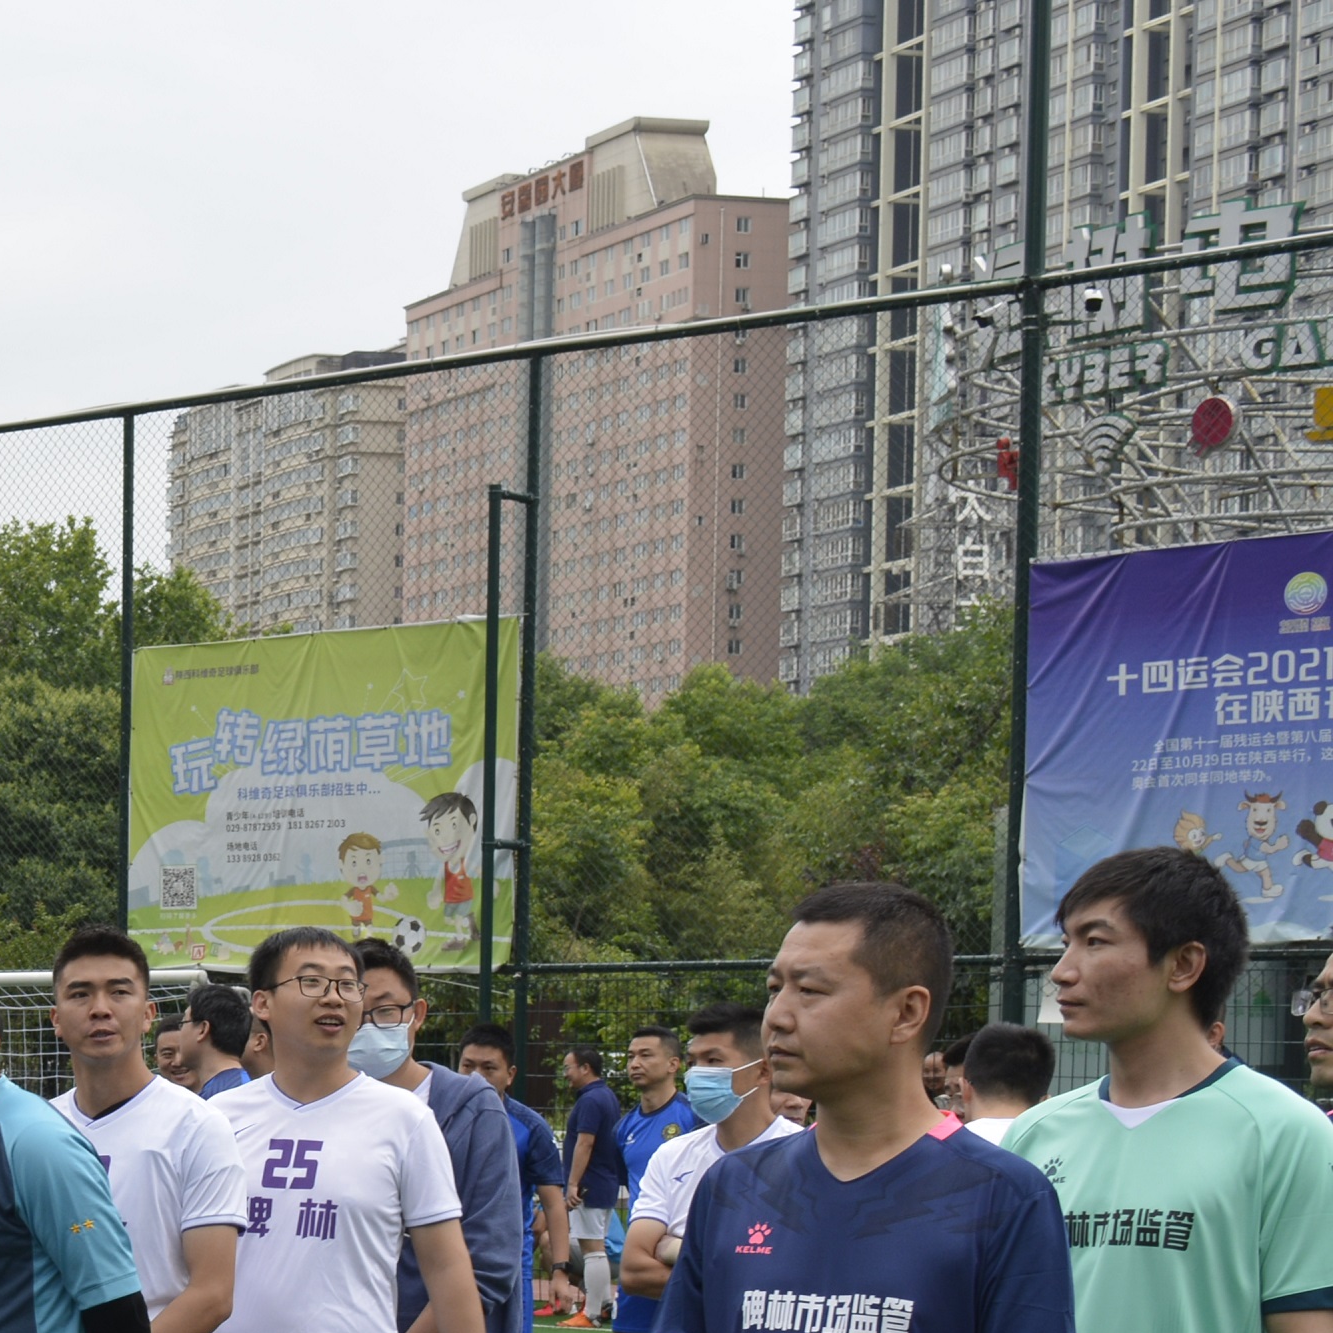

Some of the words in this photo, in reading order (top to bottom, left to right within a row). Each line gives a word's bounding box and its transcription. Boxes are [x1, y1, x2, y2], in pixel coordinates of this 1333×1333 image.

[170, 708, 452, 794] 玩转绿荫草地
[261, 1138, 324, 1190] 25
[735, 1244, 773, 1255] KELME
[1064, 1207, 1195, 1252] 林市场监管
